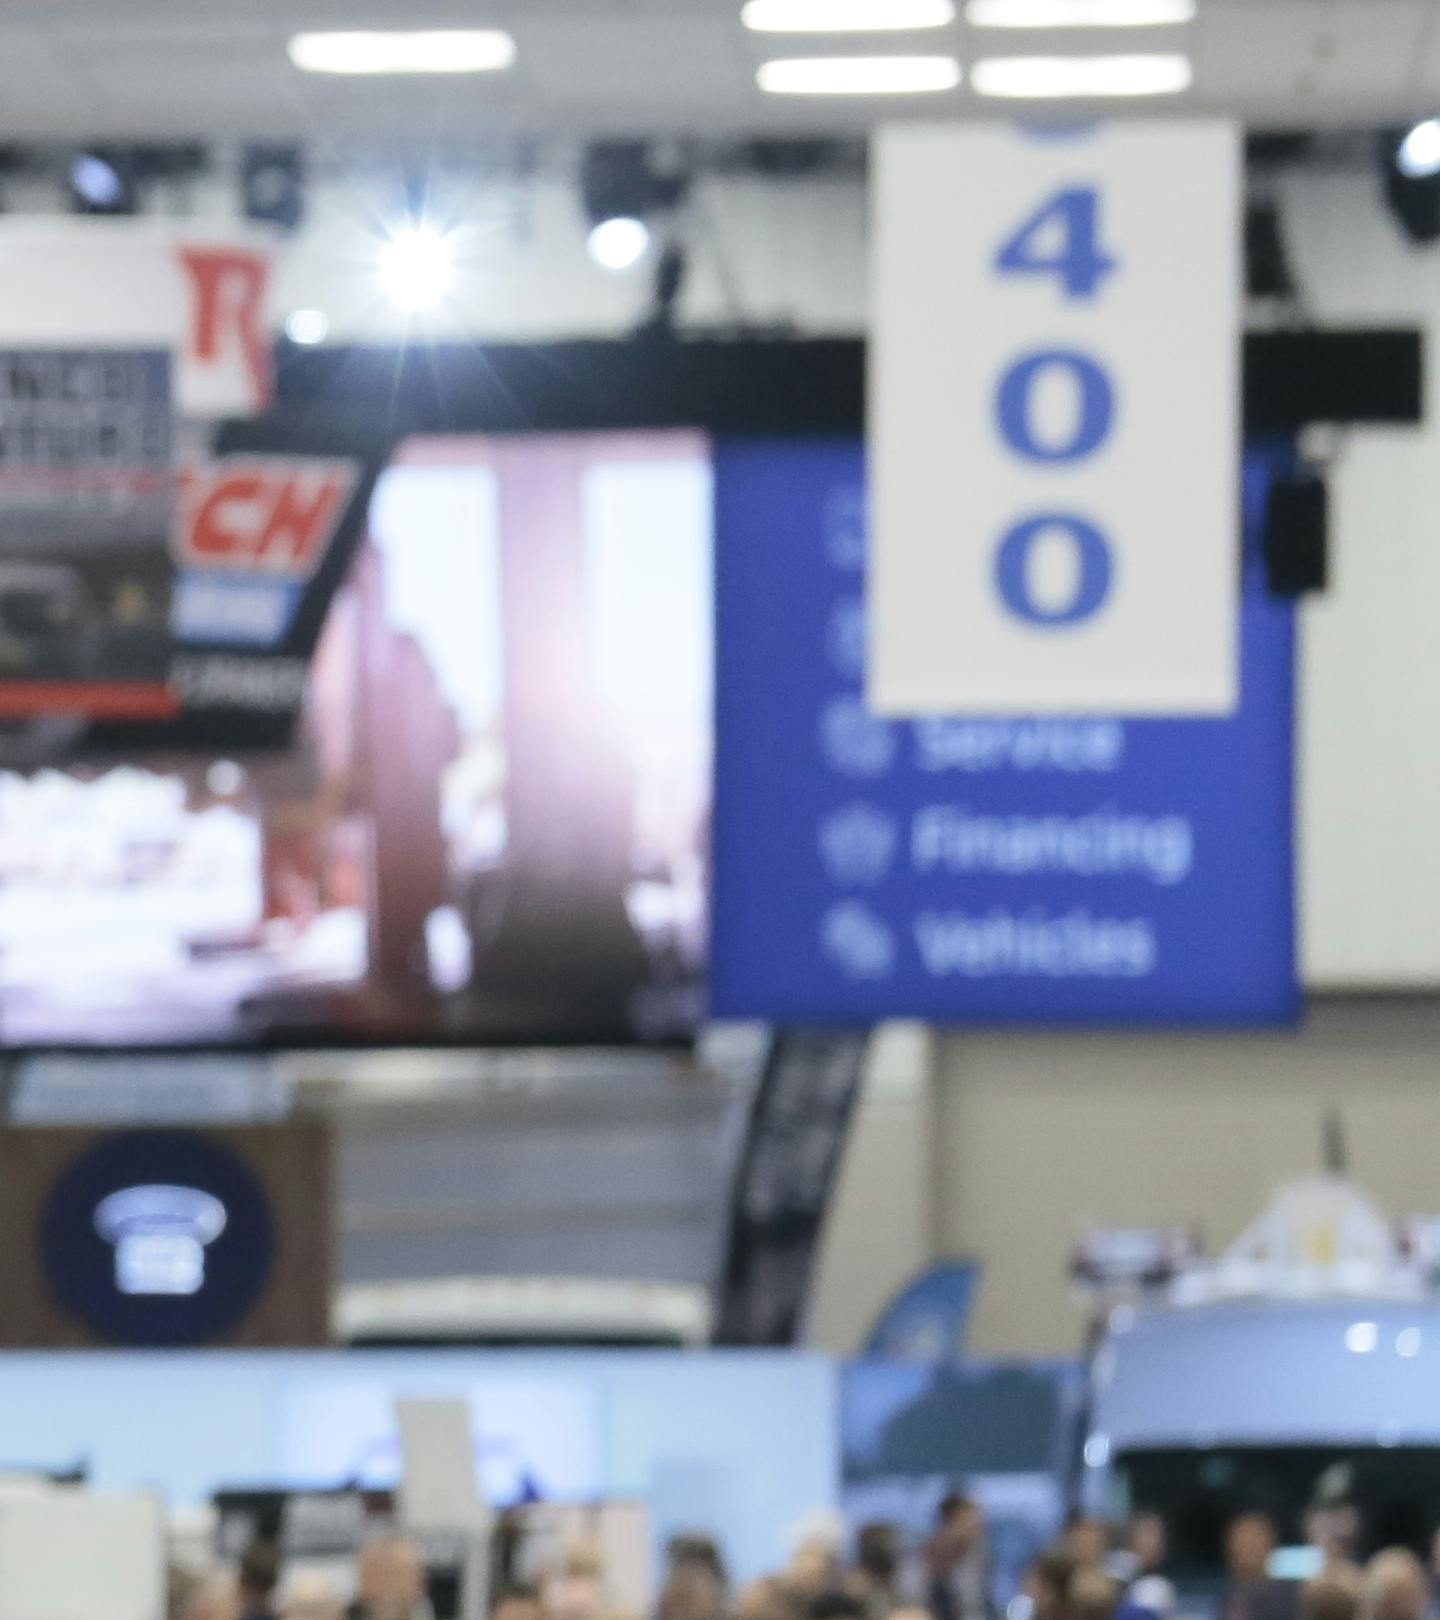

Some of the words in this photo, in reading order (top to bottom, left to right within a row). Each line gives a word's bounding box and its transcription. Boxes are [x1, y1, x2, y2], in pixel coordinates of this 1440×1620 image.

[176, 474, 344, 560] CH
[911, 804, 1194, 884] Financing
[914, 913, 1154, 979] Vehicles
